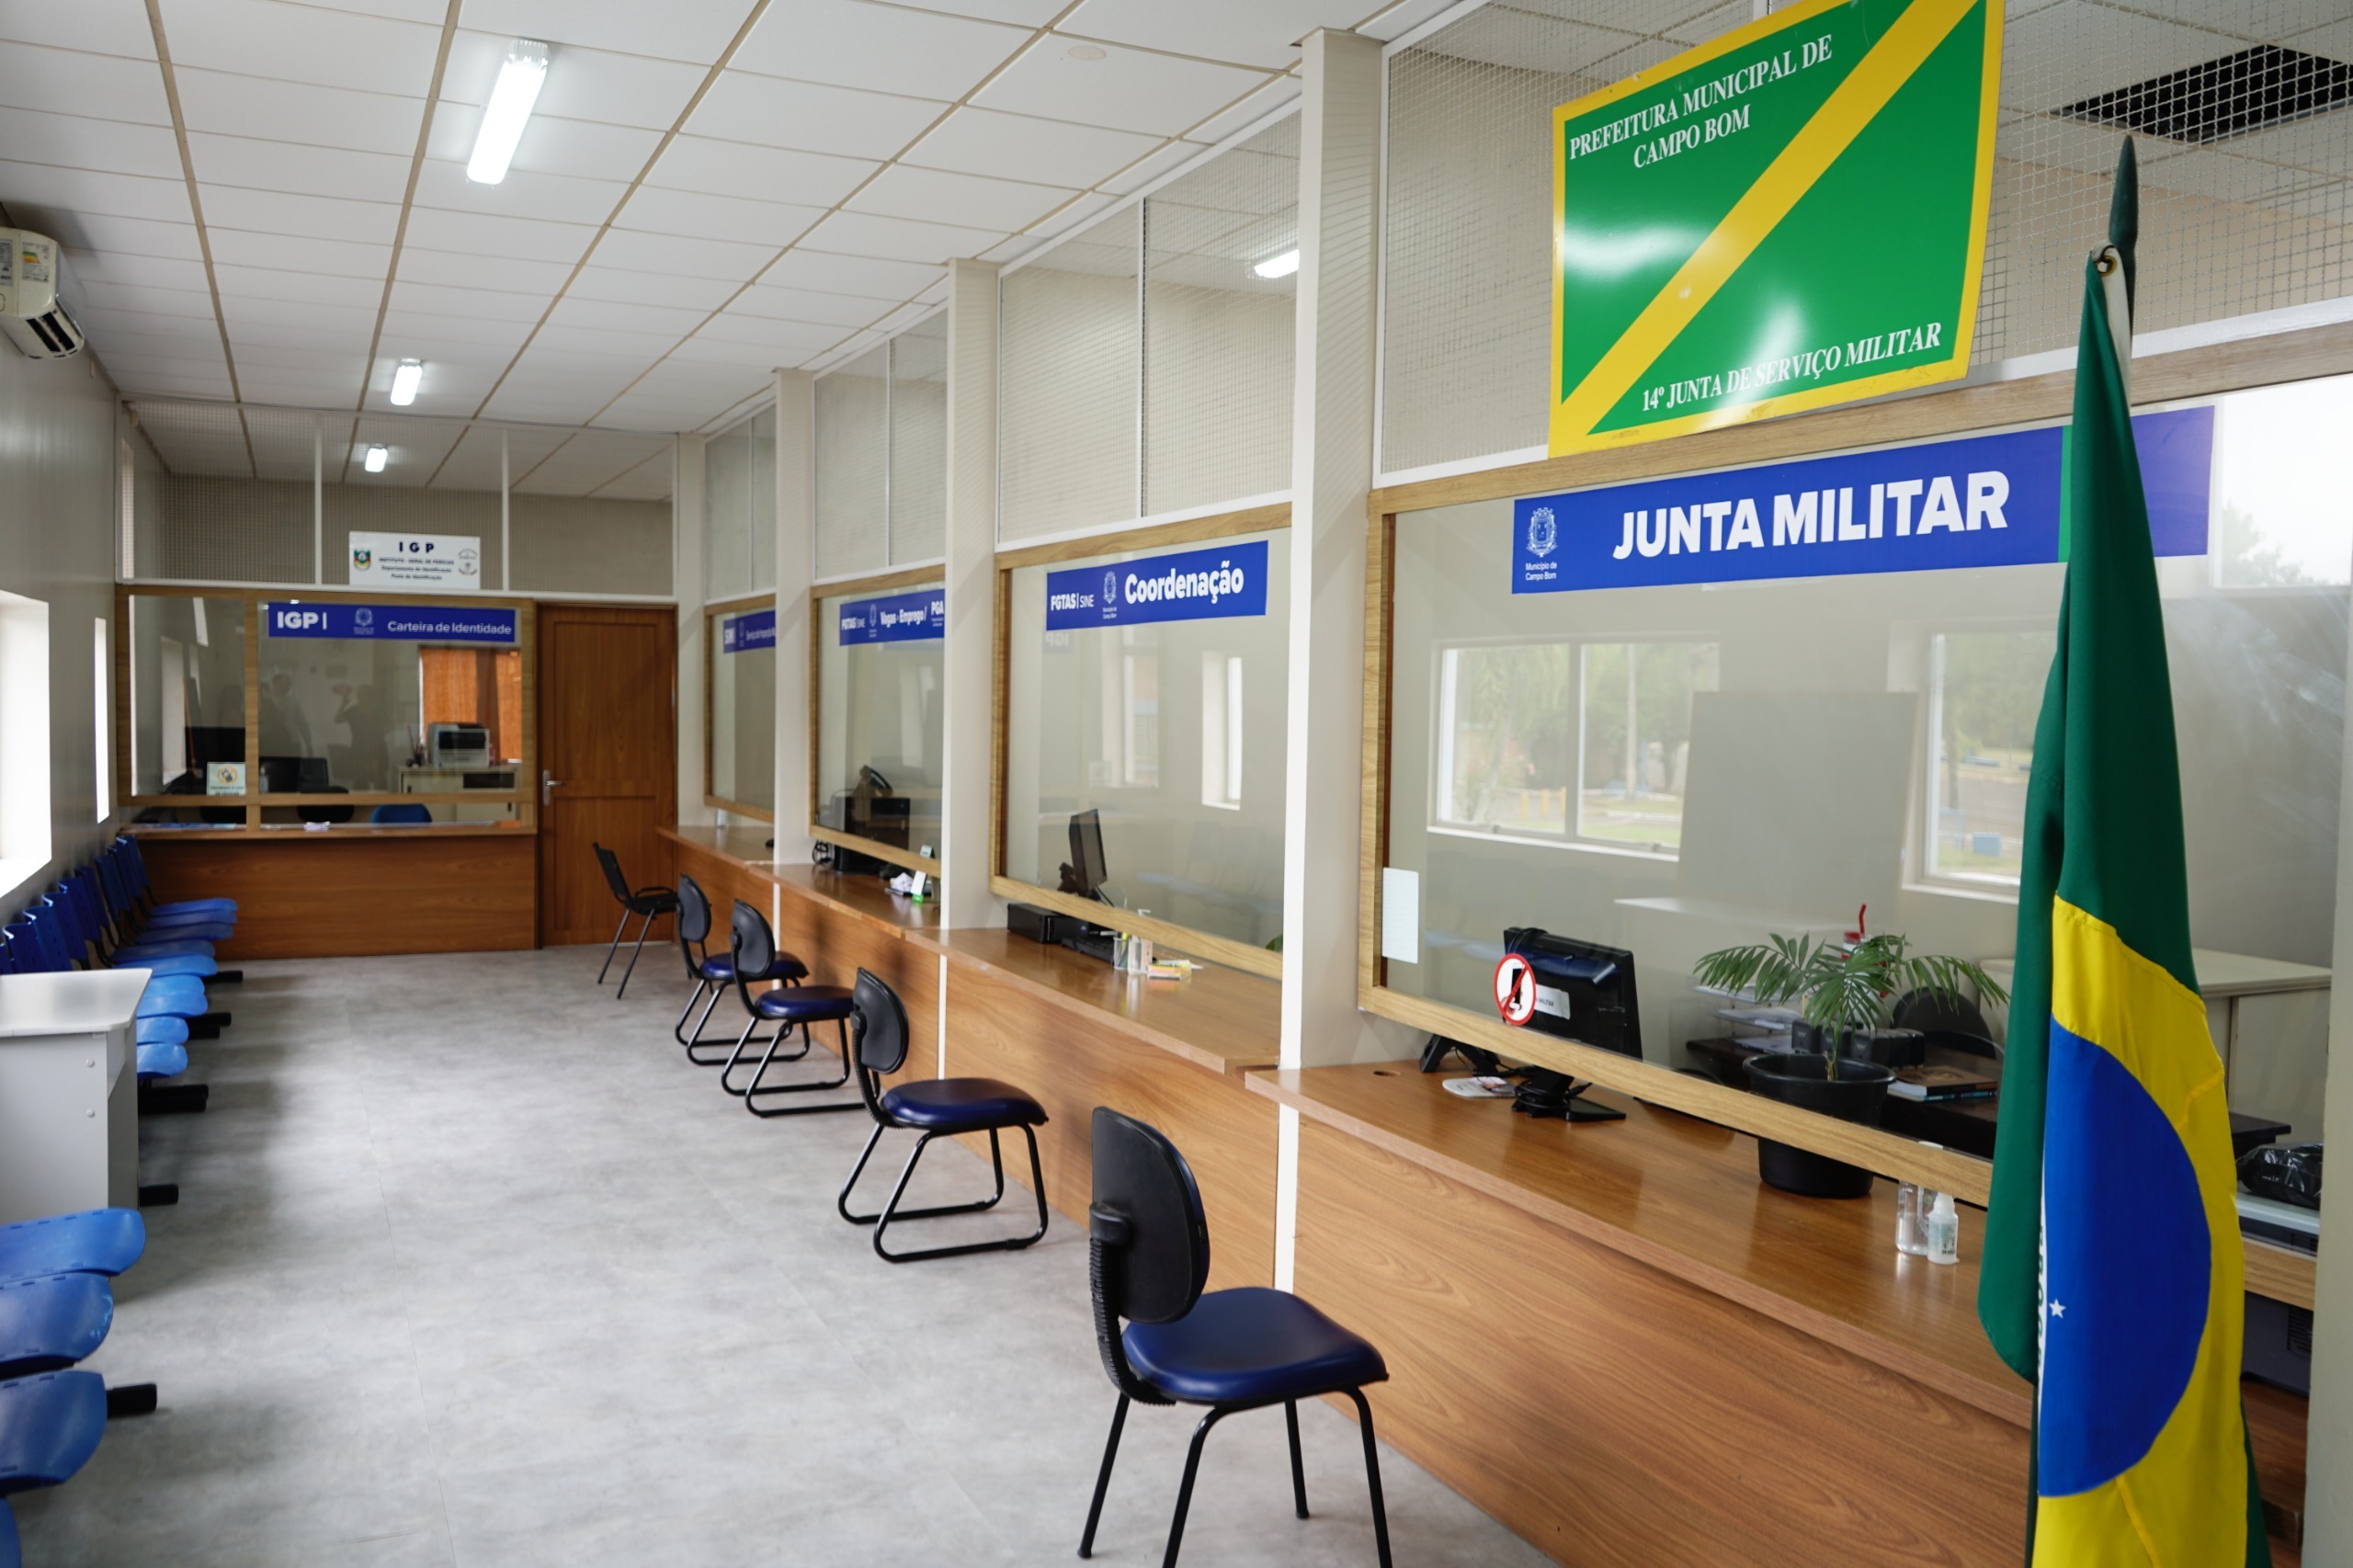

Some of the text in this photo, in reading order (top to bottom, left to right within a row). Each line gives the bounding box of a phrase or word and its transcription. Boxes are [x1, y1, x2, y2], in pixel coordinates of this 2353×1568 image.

[1569, 34, 1833, 160] PREFEITURA MUNICIPAL DE
[1633, 104, 1751, 168] CAMPO BOM
[1666, 373, 1722, 409] JUNTA
[1727, 367, 1752, 394] DE
[1755, 346, 1842, 388] SERVIÇO
[1845, 322, 1942, 368] MILITAR
[1612, 470, 2010, 560] JUNTA MILITAR
[1124, 560, 1245, 604] Coordenação
[1526, 571, 1556, 581] Campo Bom
[278, 611, 512, 634] IGP Carteira de Identidade
[881, 611, 896, 628] Vagas
[1051, 593, 1076, 610] FGTAS
